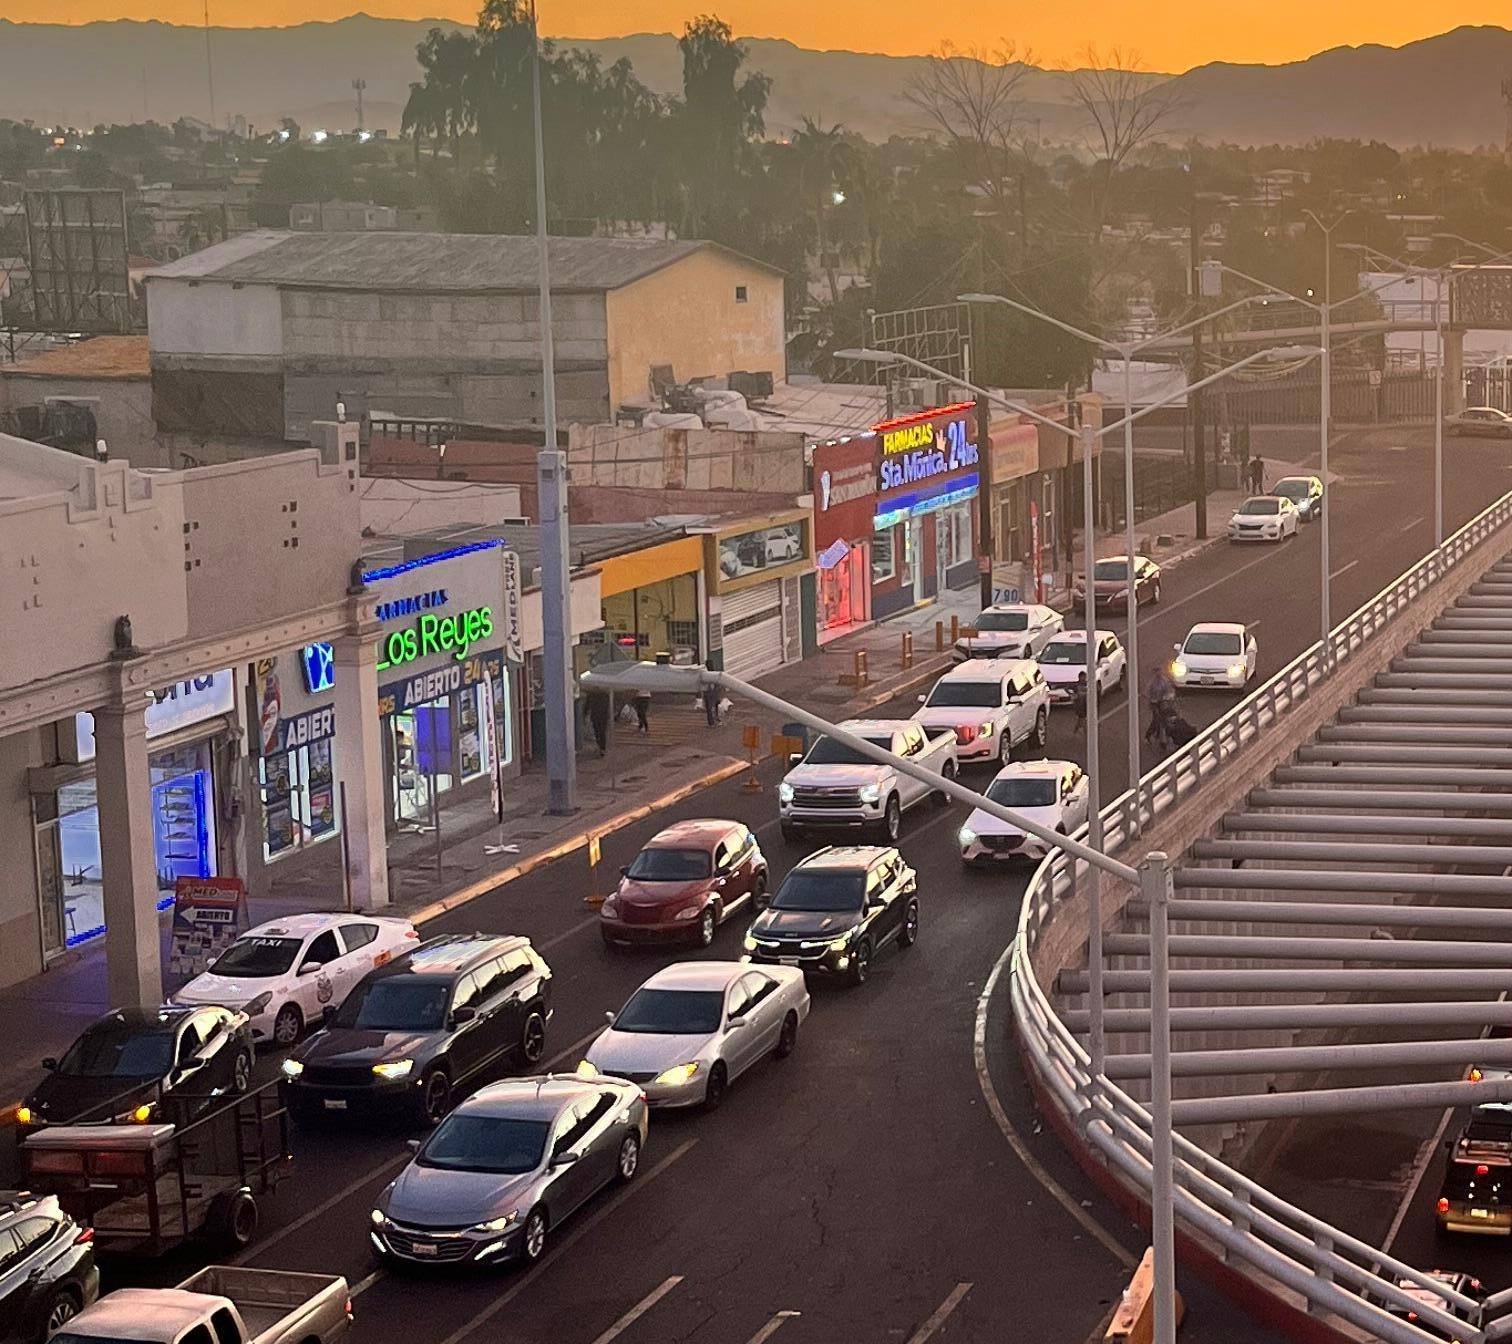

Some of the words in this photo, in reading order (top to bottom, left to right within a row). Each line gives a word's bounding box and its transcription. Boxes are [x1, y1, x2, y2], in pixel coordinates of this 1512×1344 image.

[883, 422, 933, 455] FARMACIAS
[375, 588, 448, 623] ARMACIAS
[419, 606, 494, 661] Reyes
[404, 665, 460, 706] ABIERTO
[286, 707, 335, 749] ABIER
[251, 938, 282, 948] TAXI
